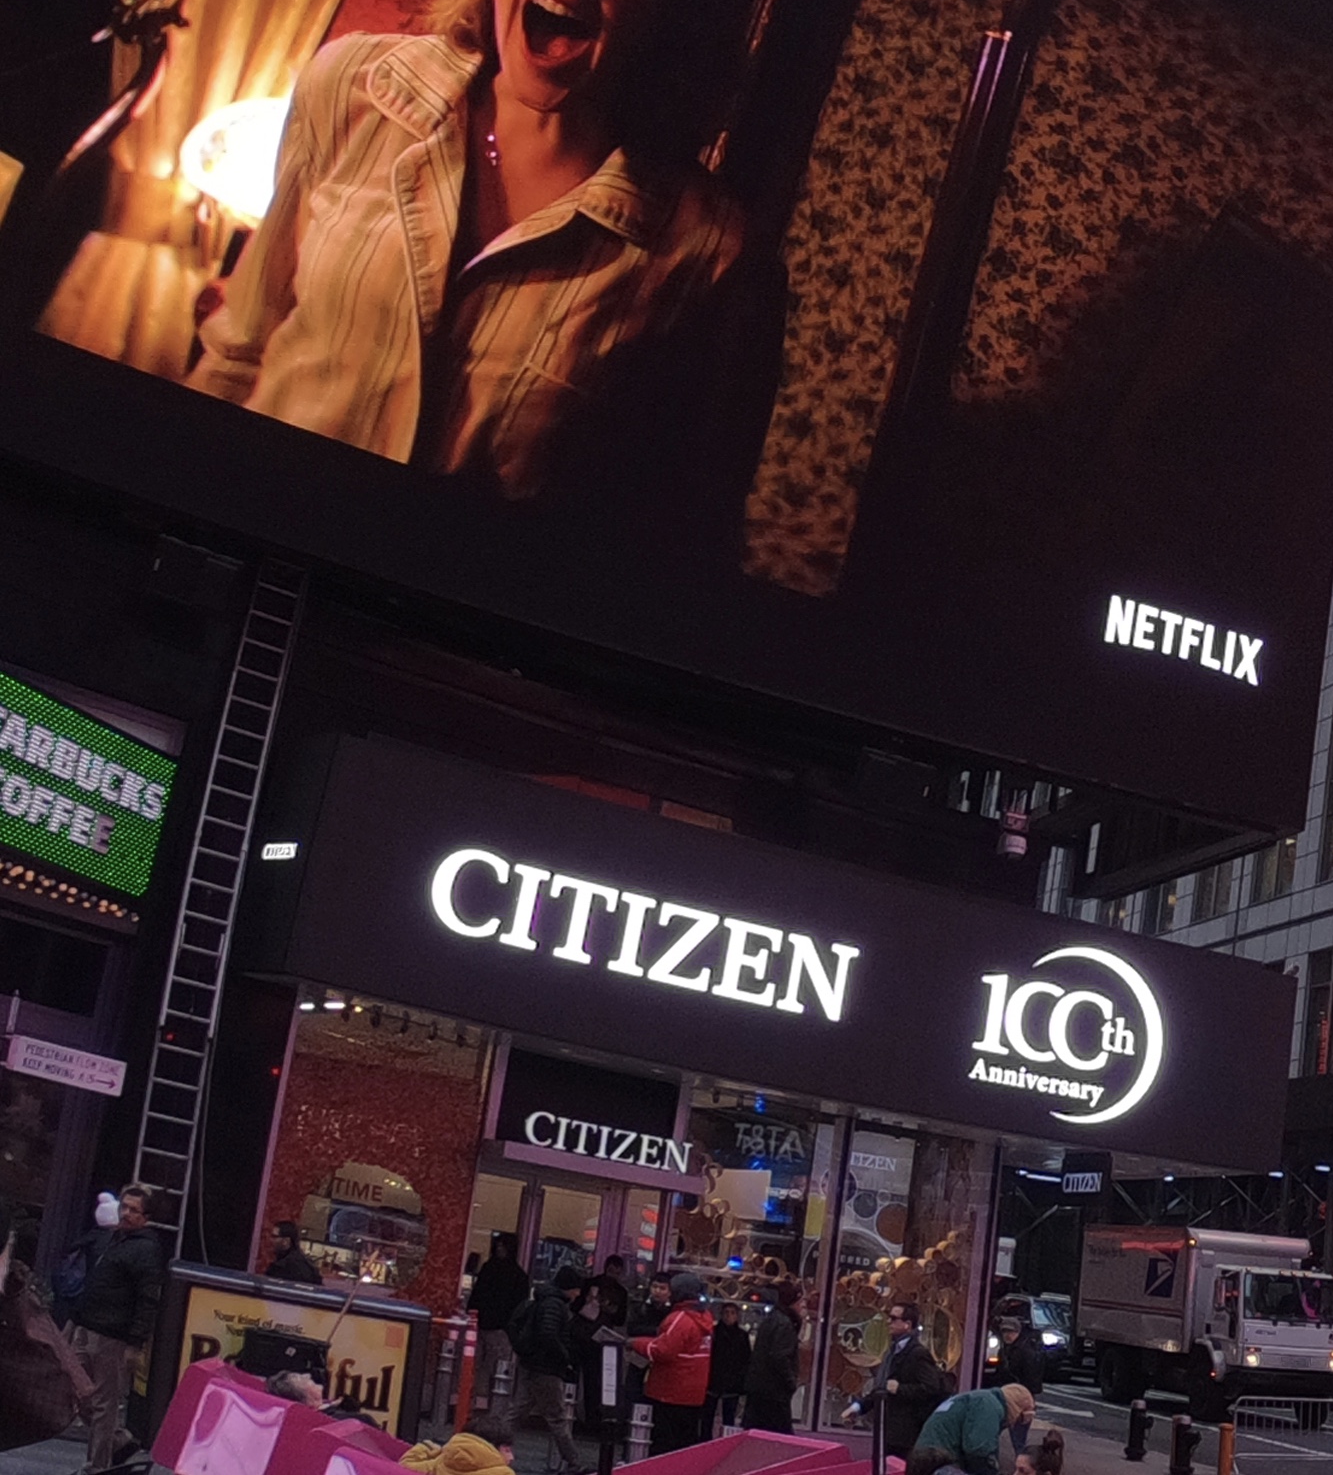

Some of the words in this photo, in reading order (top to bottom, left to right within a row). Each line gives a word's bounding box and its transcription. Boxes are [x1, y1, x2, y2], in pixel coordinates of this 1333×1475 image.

[1103, 594, 1264, 686] NETFLIX
[0, 704, 167, 823] ARBUCKS
[0, 768, 116, 856] OFFEE
[430, 846, 861, 1023] CITIZEN
[968, 1057, 1105, 1108] Anniversary
[523, 1110, 694, 1175] CITIZEN
[332, 1177, 383, 1203] TIME
[1062, 1172, 1102, 1193] CITIZEN
[214, 1309, 236, 1325] Your
[238, 1312, 262, 1328] kind
